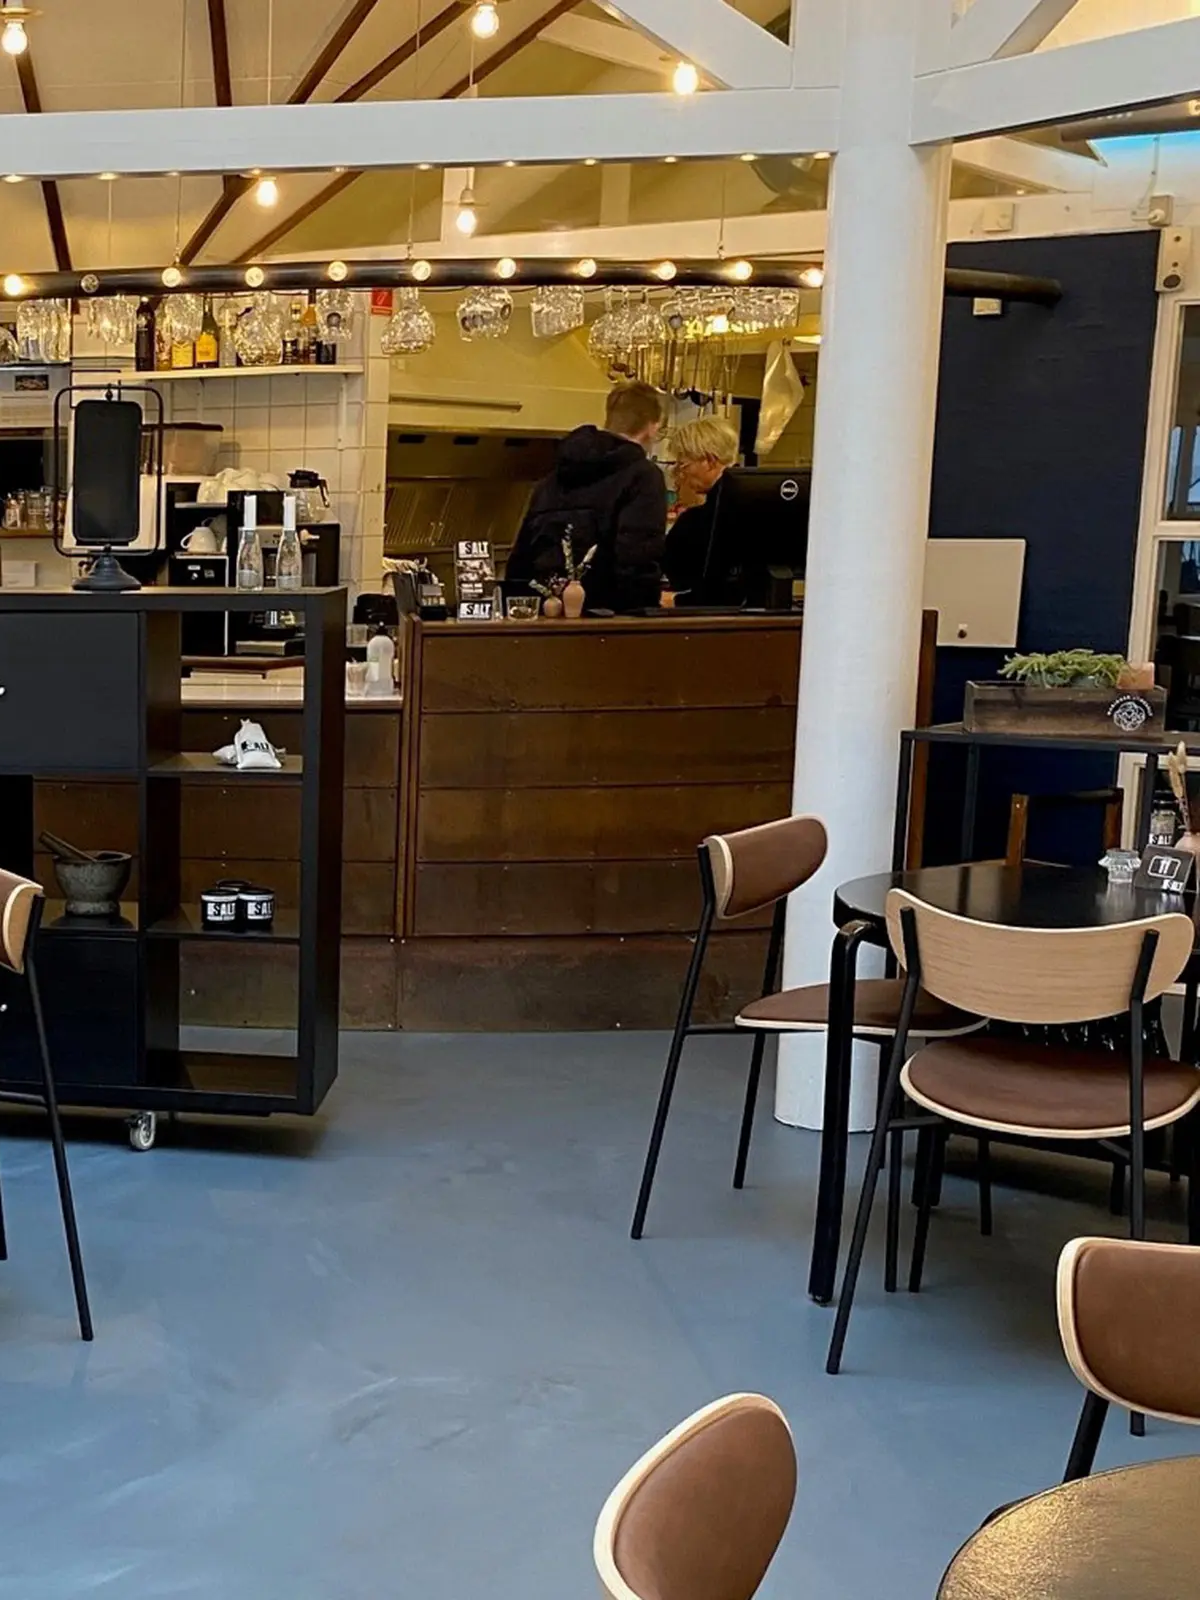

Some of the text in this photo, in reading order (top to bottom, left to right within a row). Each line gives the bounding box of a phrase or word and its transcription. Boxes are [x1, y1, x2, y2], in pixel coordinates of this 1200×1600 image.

[458, 541, 489, 556] SALT
[460, 602, 491, 616] SALT
[1149, 832, 1173, 846] SALT
[206, 901, 236, 916] SALT
[247, 901, 274, 915] SAL
